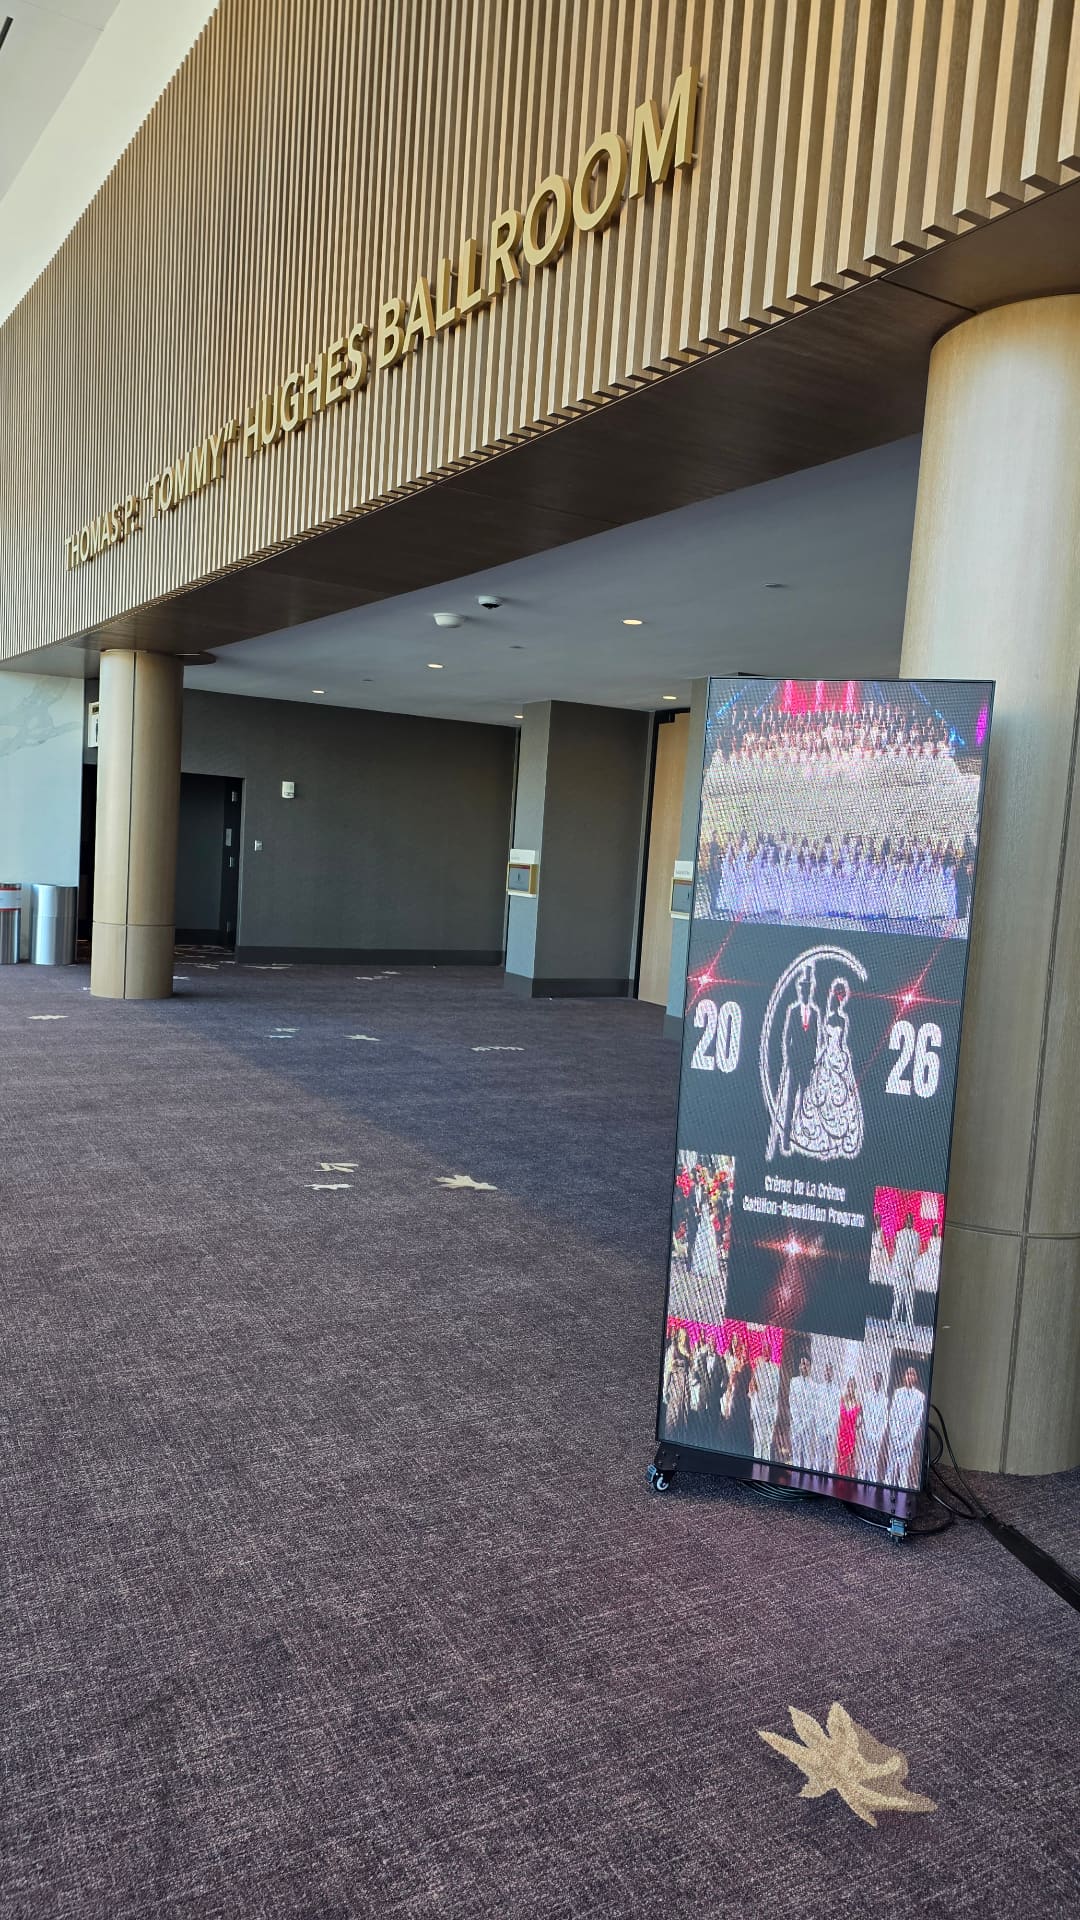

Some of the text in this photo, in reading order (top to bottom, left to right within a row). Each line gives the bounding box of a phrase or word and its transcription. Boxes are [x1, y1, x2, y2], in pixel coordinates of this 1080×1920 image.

[64, 502, 122, 571] THOMAS
[243, 323, 370, 458] HUGHES
[377, 66, 699, 370] BALLROOM
[690, 999, 942, 1098] 20 26
[793, 1178, 805, 1196] De
[805, 1180, 816, 1197] La
